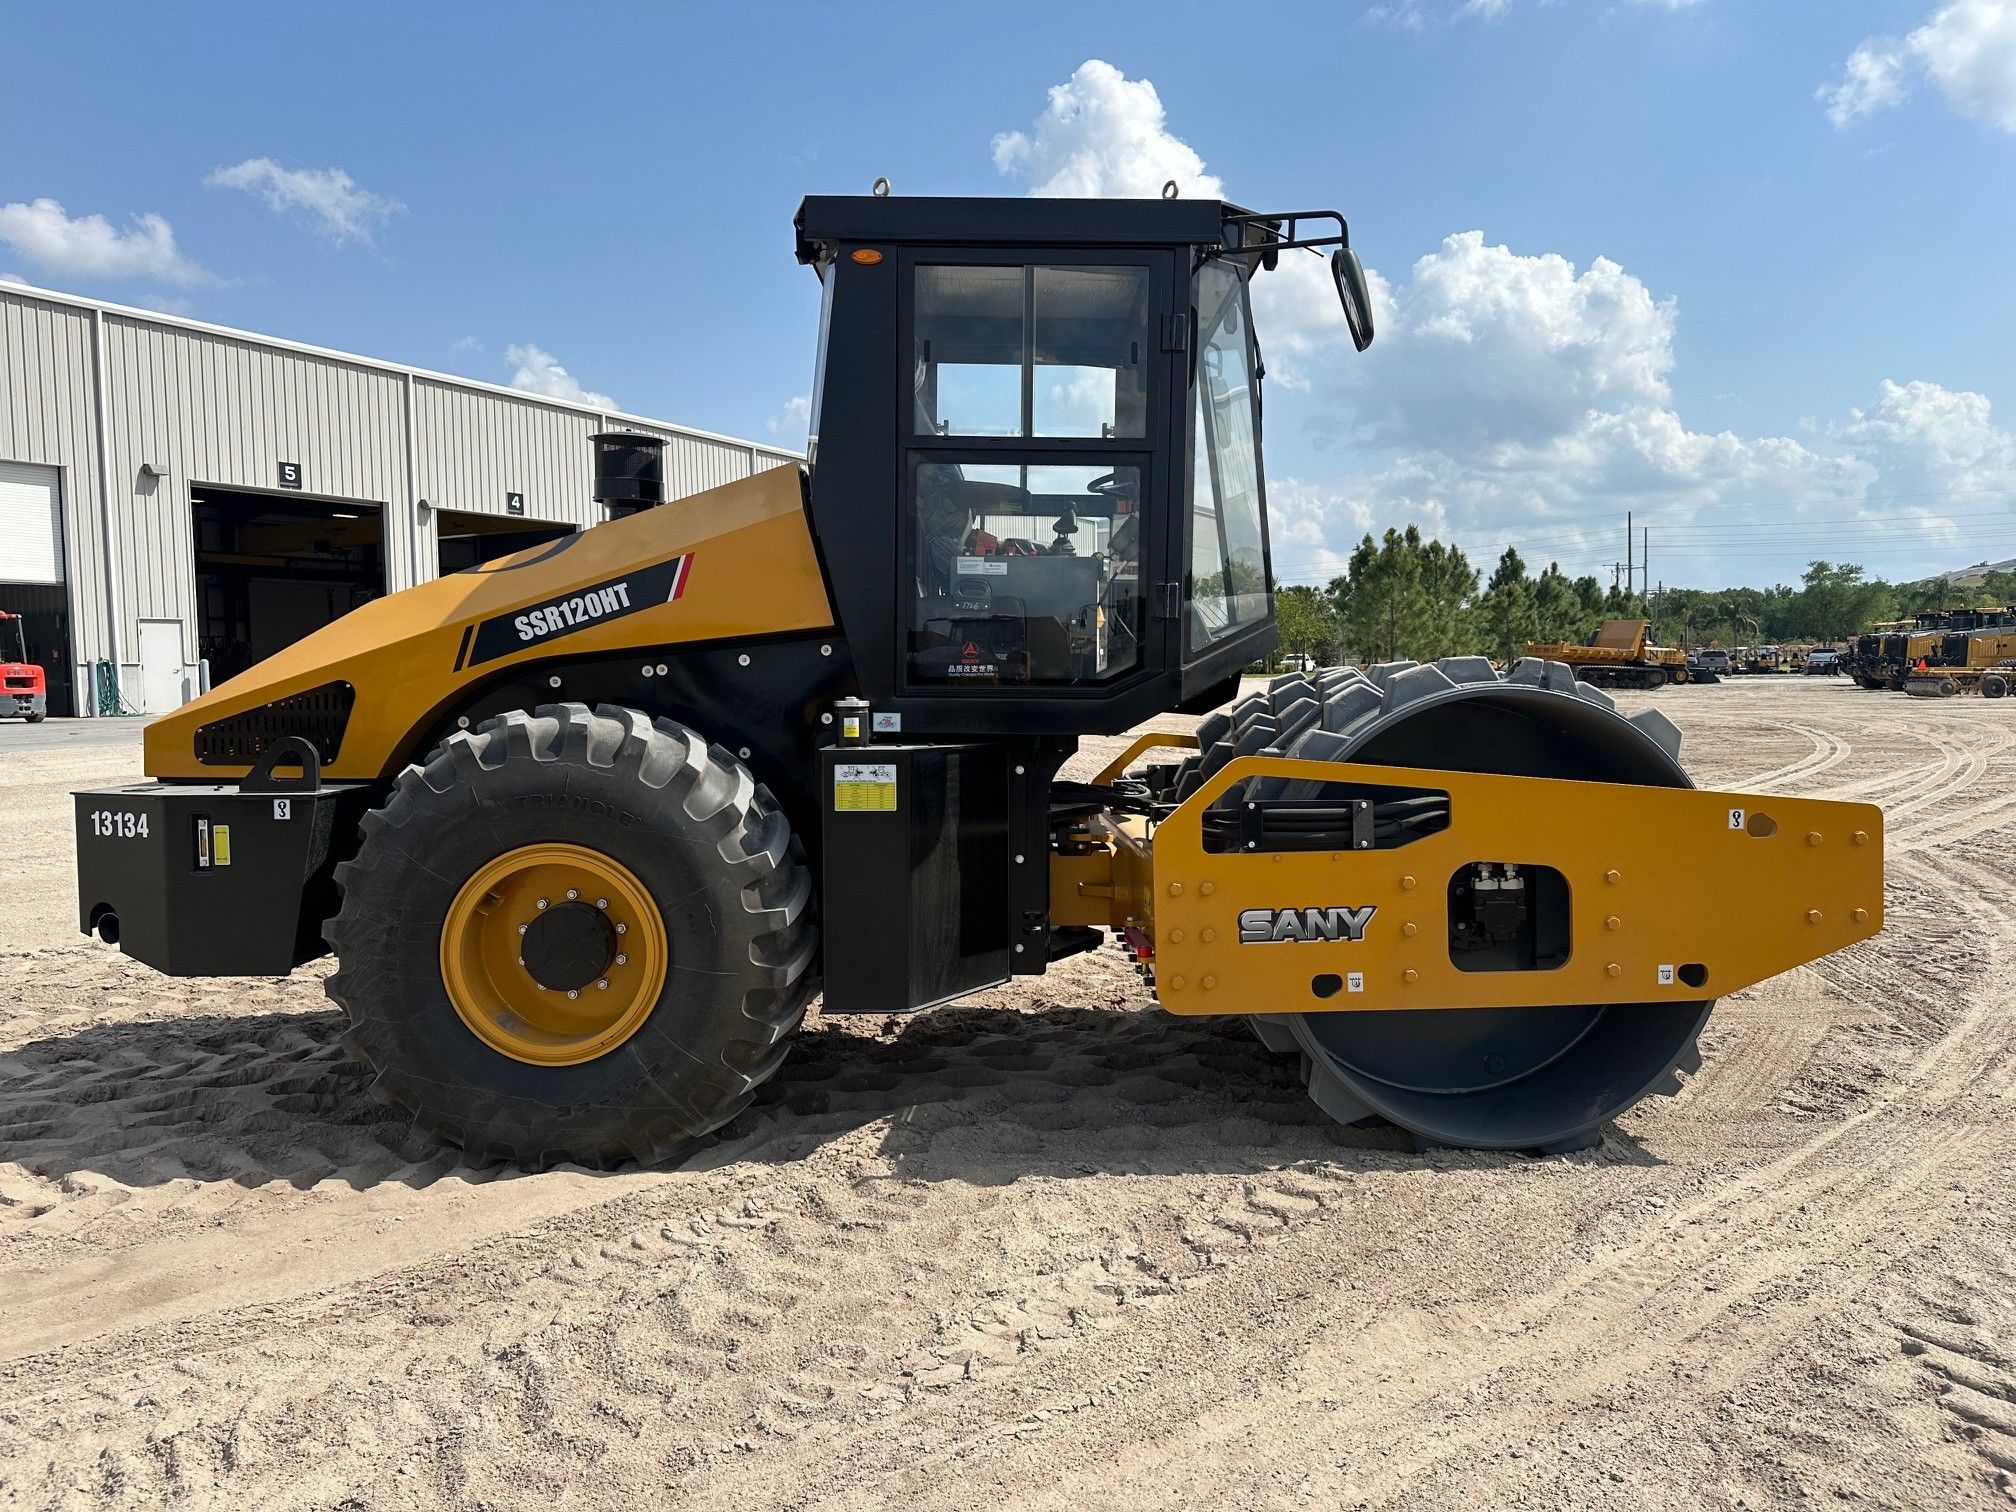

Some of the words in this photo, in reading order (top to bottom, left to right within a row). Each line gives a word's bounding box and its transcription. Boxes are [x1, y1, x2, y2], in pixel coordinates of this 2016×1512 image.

[284, 465, 296, 481] 5
[511, 495, 521, 509] 4
[514, 582, 631, 641] SSR120HT
[948, 665, 994, 673] 品质改变世界
[91, 810, 149, 838] 13134
[514, 793, 637, 828] TRIANGLE
[1238, 906, 1377, 944] SANY
